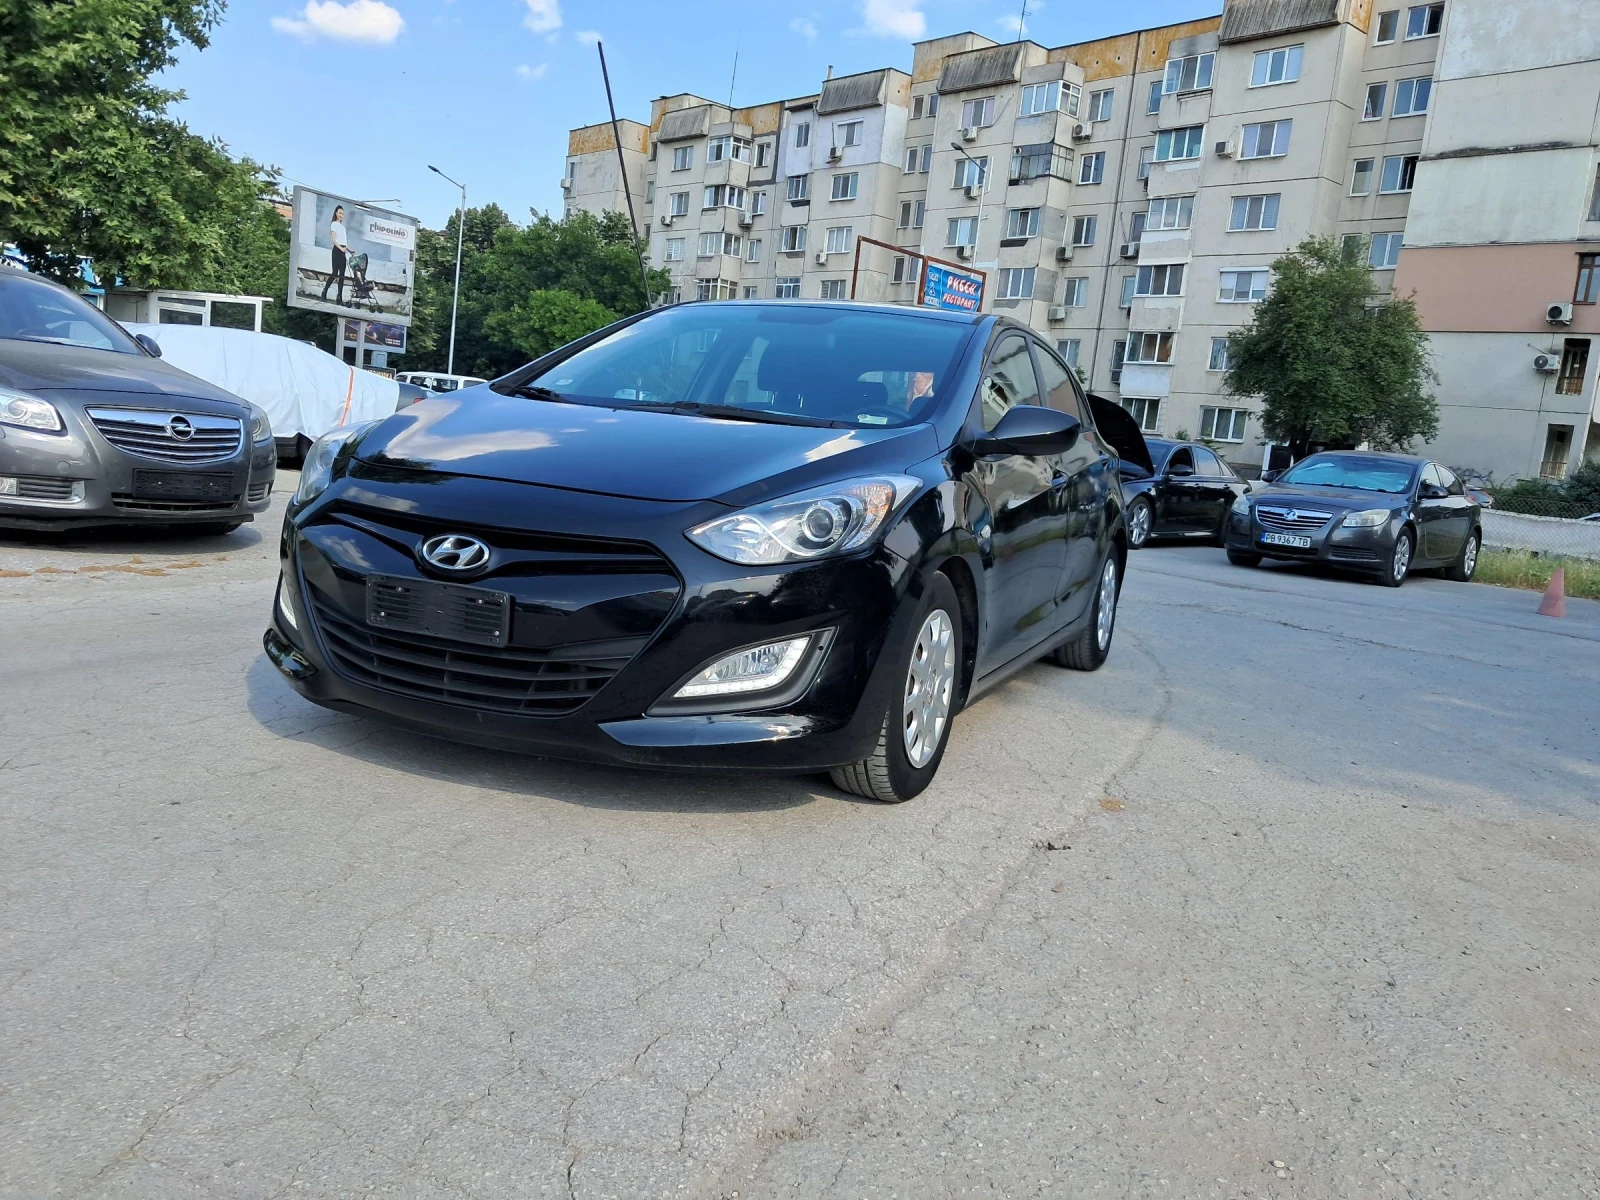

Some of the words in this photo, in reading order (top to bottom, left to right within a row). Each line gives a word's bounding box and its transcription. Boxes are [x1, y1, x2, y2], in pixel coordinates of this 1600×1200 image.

[943, 293, 976, 309] РЕСТОРАНТ
[1277, 535, 1297, 545] 9367
[1298, 537, 1309, 546] TB
